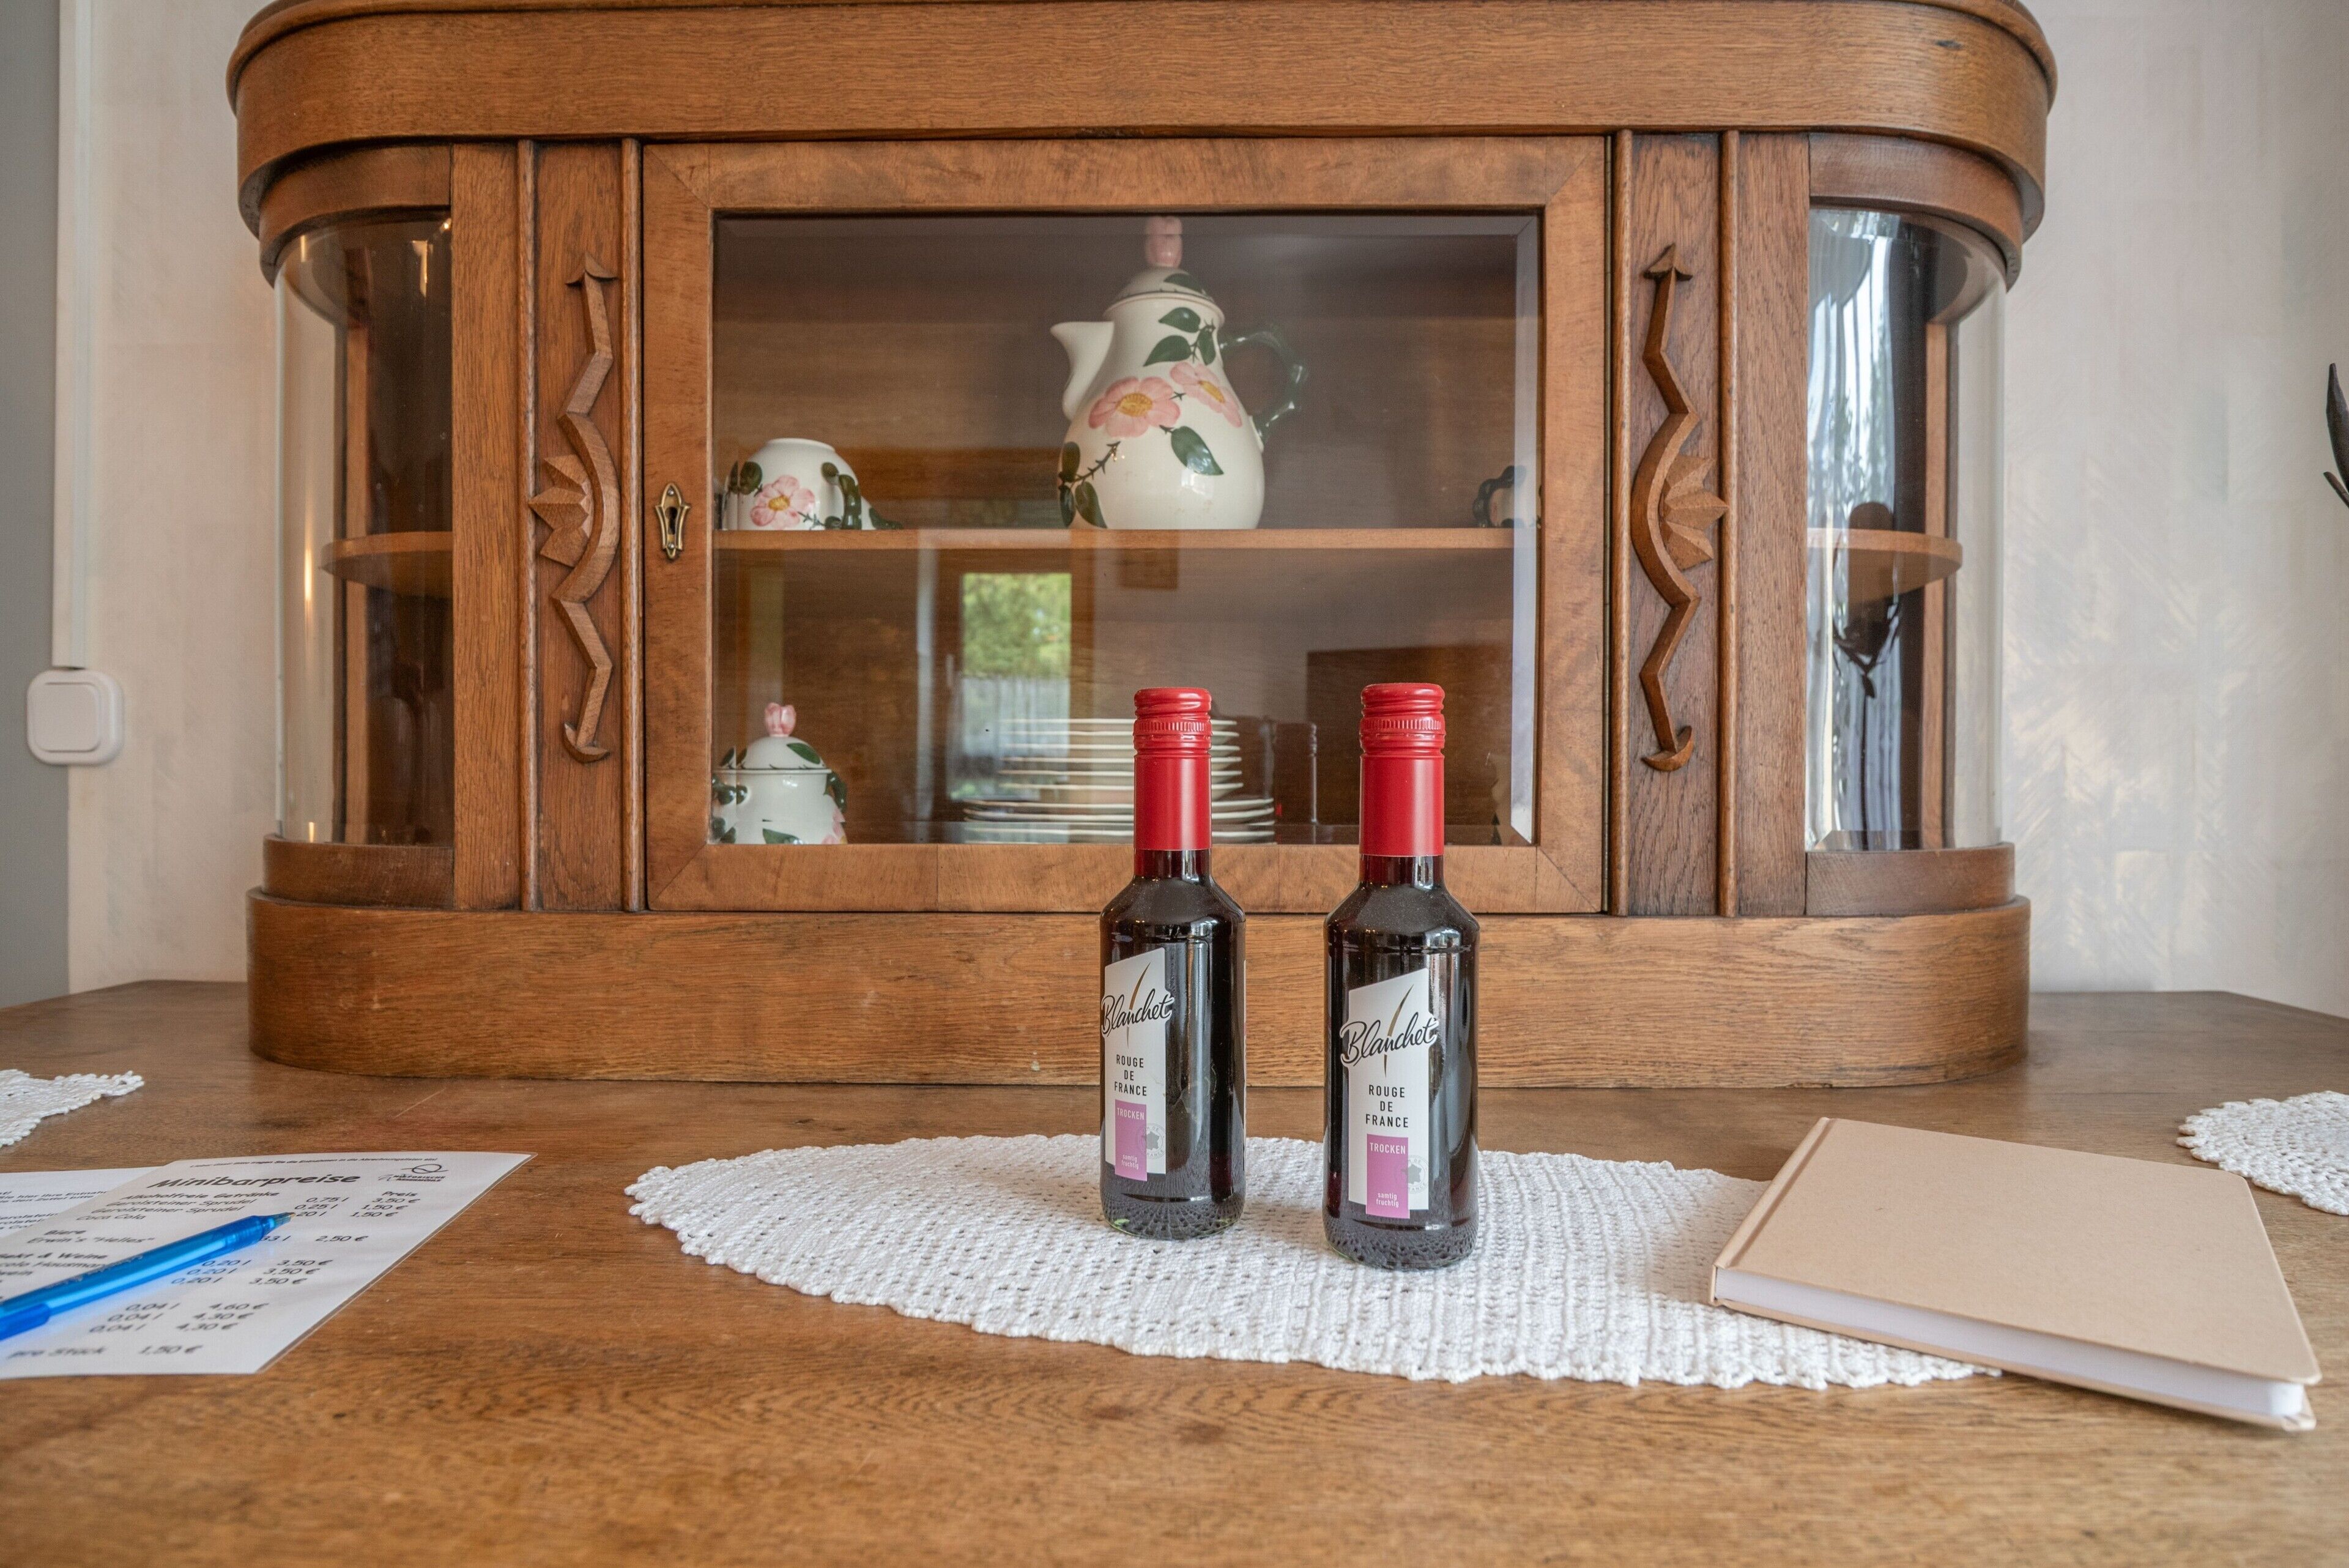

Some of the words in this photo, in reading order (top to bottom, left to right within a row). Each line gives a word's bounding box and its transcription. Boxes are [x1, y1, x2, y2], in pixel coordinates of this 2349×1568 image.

[1102, 988, 1173, 1037] Blanchet
[1341, 1011, 1438, 1066] Blanchet
[1116, 1054, 1144, 1068] ROUGE
[1124, 1069, 1134, 1081] DE
[1114, 1081, 1147, 1096] FRANCE
[1369, 1085, 1405, 1098] ROUGE
[1380, 1101, 1393, 1112] DE
[1117, 1107, 1145, 1120] TROCKEN
[1366, 1113, 1408, 1128] FRANCE
[1370, 1142, 1406, 1154] TROCKEN
[1121, 1159, 1139, 1170] fruchtig
[1123, 1154, 1138, 1163] samtig
[146, 1174, 361, 1188] Minibarpreise
[1376, 1198, 1399, 1208] fruchtig
[108, 1313, 150, 1322] 0,04
[184, 1345, 204, 1354] €
